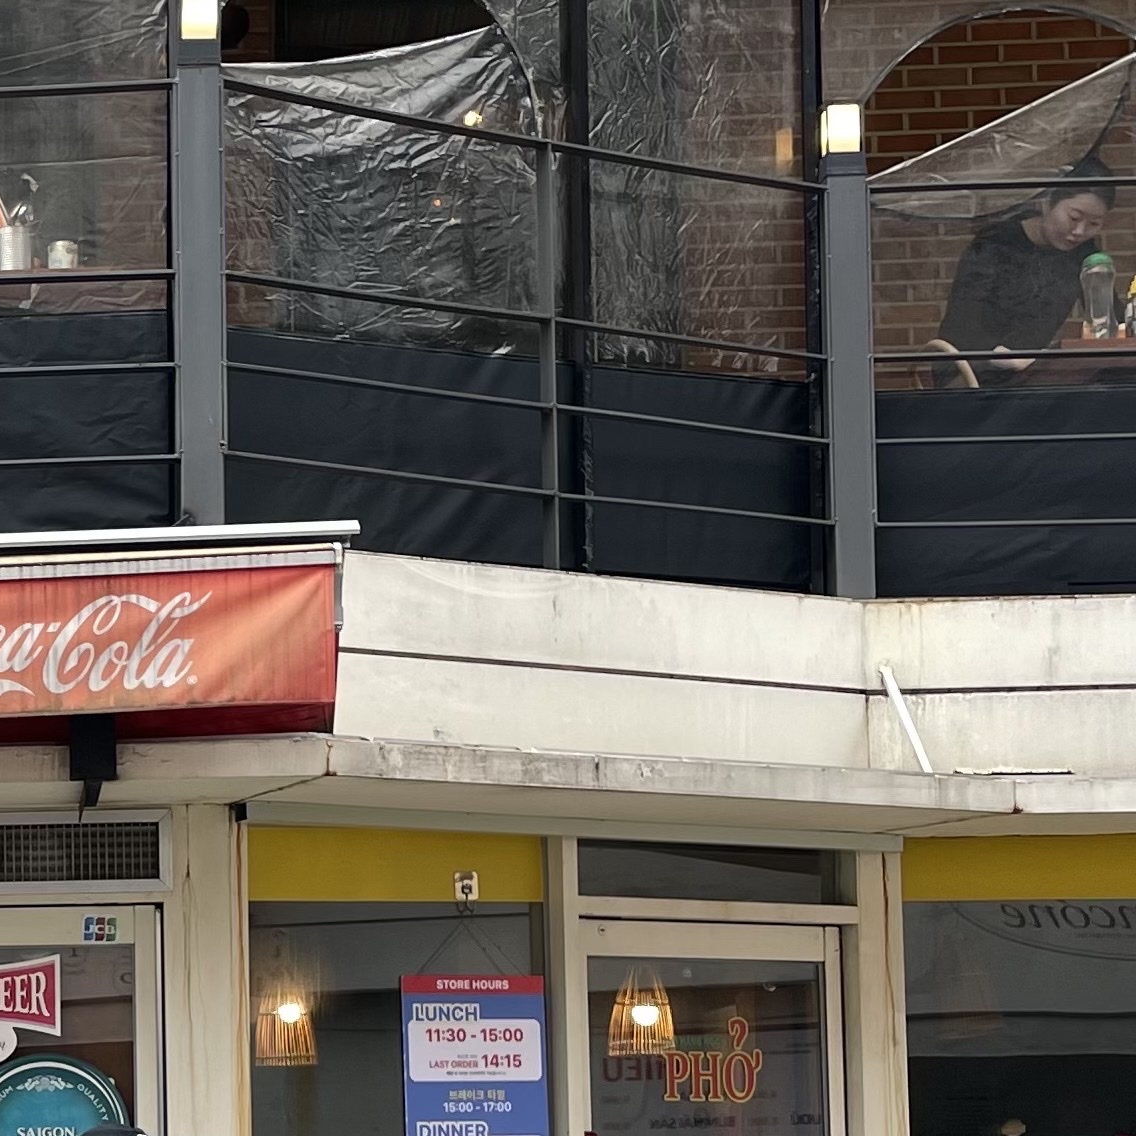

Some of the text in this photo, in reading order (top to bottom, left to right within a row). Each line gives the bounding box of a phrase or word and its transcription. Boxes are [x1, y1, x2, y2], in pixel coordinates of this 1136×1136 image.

[436, 979, 509, 990] STORE HOURS
[414, 1004, 479, 1022] LUNCH
[425, 1028, 466, 1042] 11:30
[480, 1028, 524, 1042] 15:00
[429, 1060, 450, 1069] LAST
[451, 1060, 479, 1068] ORDER
[481, 1053, 523, 1068] 14:15
[663, 1016, 763, 1103] PHỞ
[77, 1083, 109, 1121] QUALITY
[449, 1089, 484, 1101] 브레이크
[442, 1101, 474, 1113] 15:00
[482, 1101, 513, 1113] 17:00
